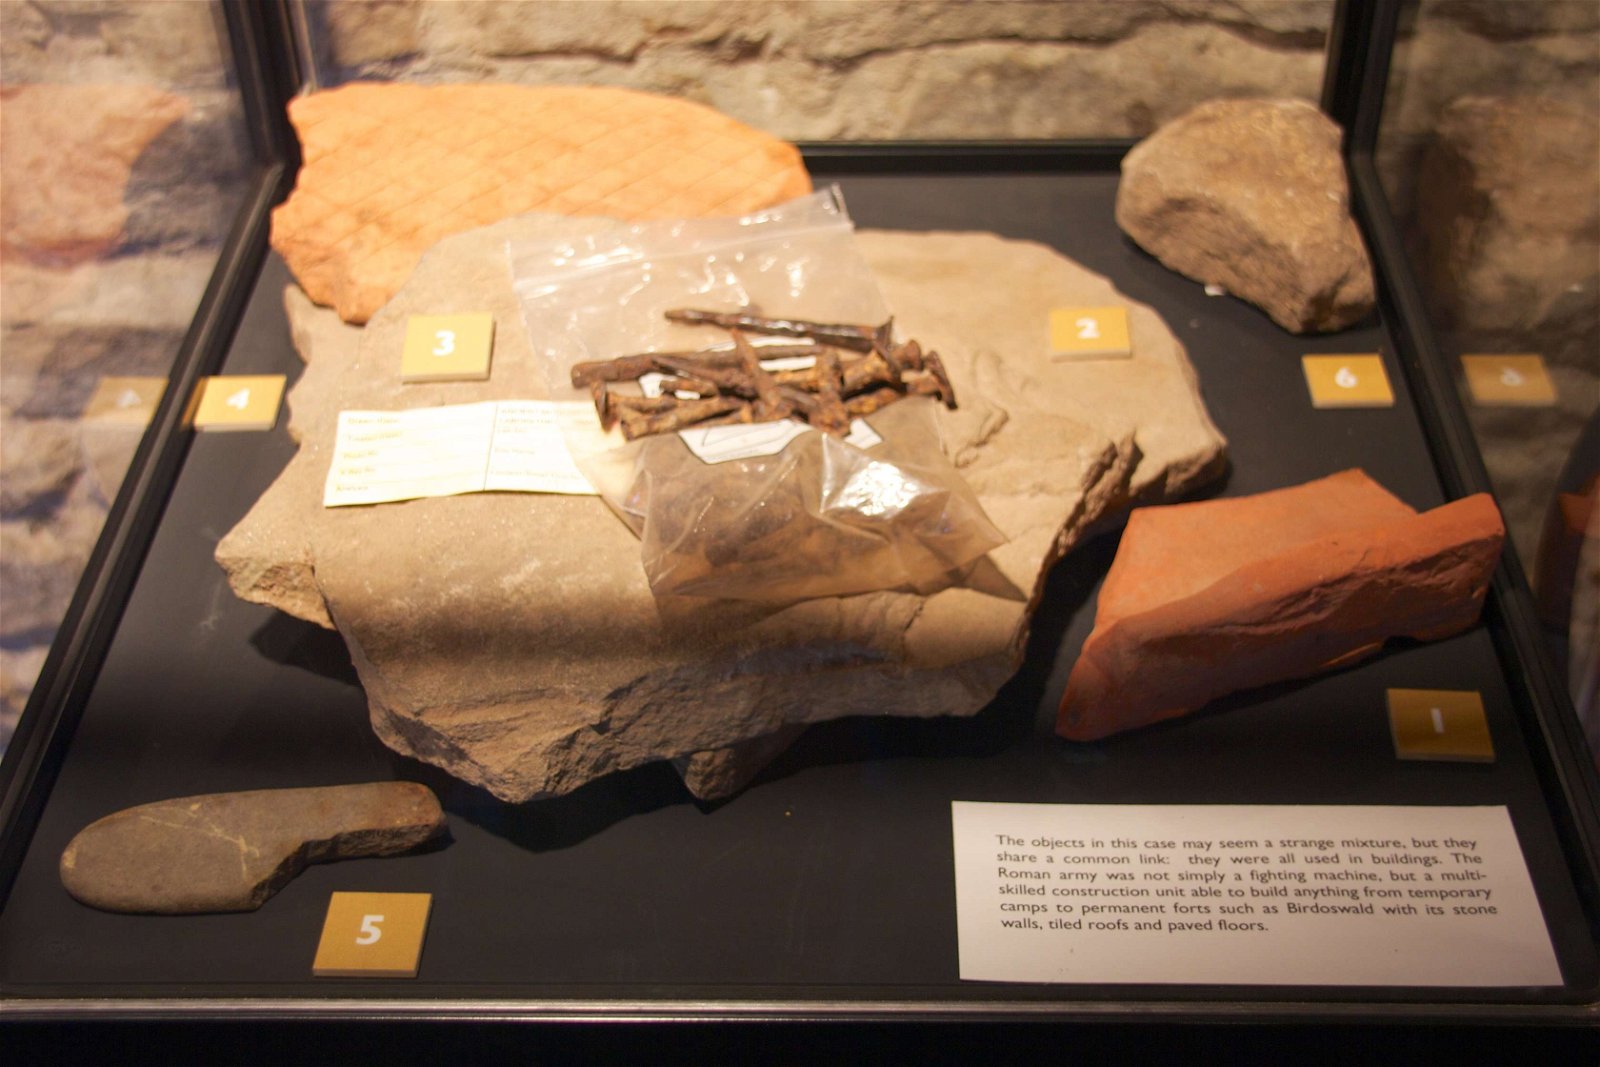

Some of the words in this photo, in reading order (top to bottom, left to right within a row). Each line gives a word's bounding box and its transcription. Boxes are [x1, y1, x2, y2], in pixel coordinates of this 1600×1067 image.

[1075, 317, 1101, 339] 2
[432, 330, 455, 356] 3
[1334, 366, 1358, 389] 6
[225, 387, 251, 411] 4
[1430, 708, 1444, 733] 1
[997, 834, 1025, 847] The
[1032, 837, 1085, 850] objects
[1092, 840, 1105, 849] in
[1111, 837, 1138, 849] this
[1144, 840, 1177, 849] case
[1183, 840, 1213, 852] may
[1219, 839, 1259, 849] seem
[1265, 839, 1274, 849] a
[1280, 839, 1336, 852] strange
[1341, 838, 1407, 850] mixture,
[1411, 837, 1440, 849] but
[1443, 838, 1476, 851] they
[997, 850, 1037, 863] share
[1047, 855, 1055, 864] a
[1064, 855, 1131, 865] common
[1140, 853, 1170, 865] link:
[1189, 854, 1220, 867] they
[1230, 855, 1270, 865] were
[1279, 852, 1296, 864] all
[1305, 852, 1341, 865] used
[1349, 854, 1364, 865] in
[1371, 854, 1442, 867] buildings.
[1451, 852, 1483, 865] The
[998, 867, 1051, 879] Roman
[1060, 871, 1098, 884] army
[1106, 872, 1136, 881] was
[1144, 872, 1171, 881] not
[1178, 871, 1225, 884] simply
[1234, 872, 1243, 882] a
[1250, 870, 1307, 884] fighting
[1314, 870, 1382, 882] machine,
[1389, 869, 1418, 882] but
[1424, 872, 1434, 882] a
[1441, 869, 1487, 882] multi-
[999, 883, 1046, 896] skilled
[1052, 886, 1150, 897] construction
[1156, 886, 1186, 898] unit
[1191, 885, 1223, 898] able
[1228, 888, 1246, 898] to
[1250, 885, 1289, 898] build
[1294, 886, 1360, 900] anything
[1363, 886, 1402, 898] from
[1408, 889, 1491, 901] temporary
[1000, 903, 1048, 915] camps
[1056, 904, 1074, 914] to
[1082, 904, 1167, 917] permanent
[1173, 902, 1211, 914] forts
[1219, 902, 1255, 915] such
[1263, 905, 1279, 915] as
[1287, 902, 1374, 914] Birdoswald
[1382, 903, 1418, 916] with
[1425, 903, 1446, 916] its
[1453, 905, 1498, 916] stone
[356, 915, 384, 945] 5
[1001, 918, 1043, 930] walls,
[1049, 917, 1083, 930] tiled
[1088, 918, 1130, 931] roofs
[1134, 918, 1163, 931] and
[1168, 920, 1213, 933] paved
[1218, 919, 1268, 931] floors.
